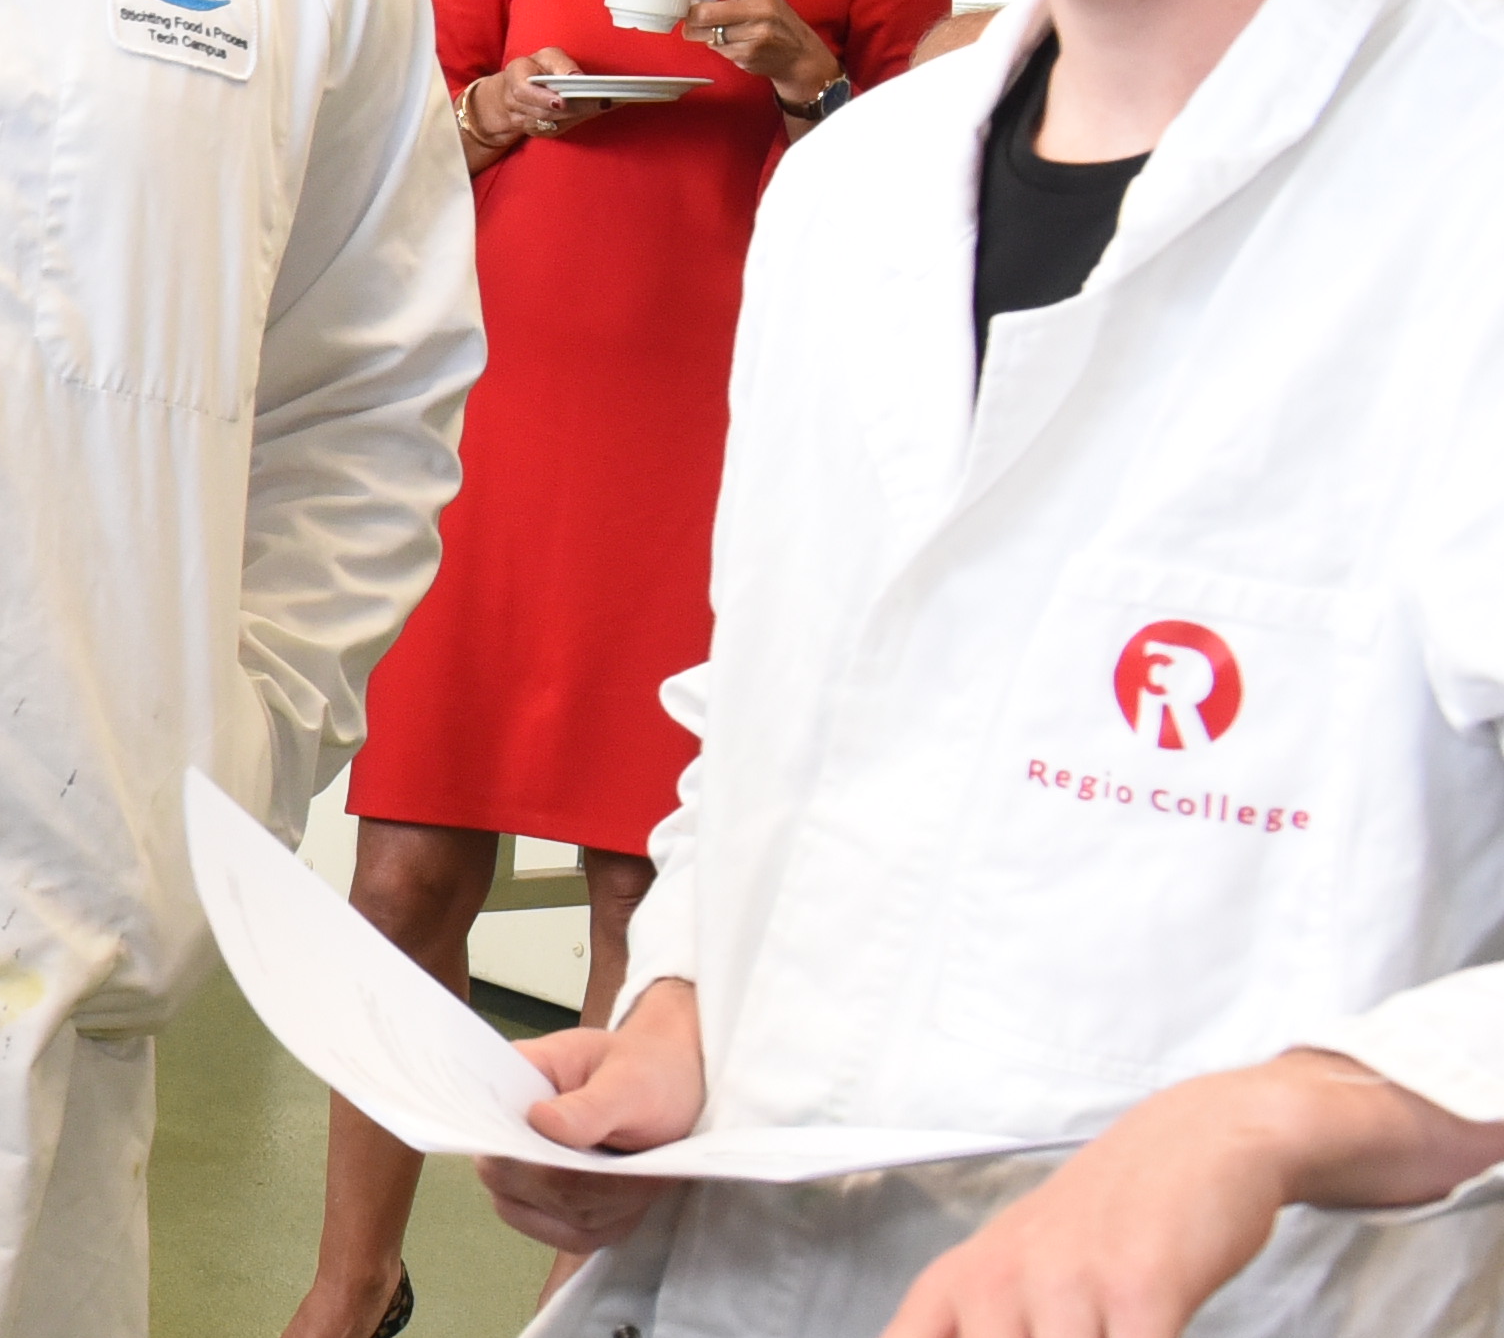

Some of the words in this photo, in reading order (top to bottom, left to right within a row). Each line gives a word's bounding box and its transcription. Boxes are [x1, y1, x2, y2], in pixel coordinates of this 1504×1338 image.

[120, 7, 171, 30] Stichting
[174, 15, 203, 34] Food
[148, 28, 178, 46] Tech
[181, 35, 227, 59] Campus
[1028, 759, 1133, 803] Regio
[1151, 788, 1310, 833] College
